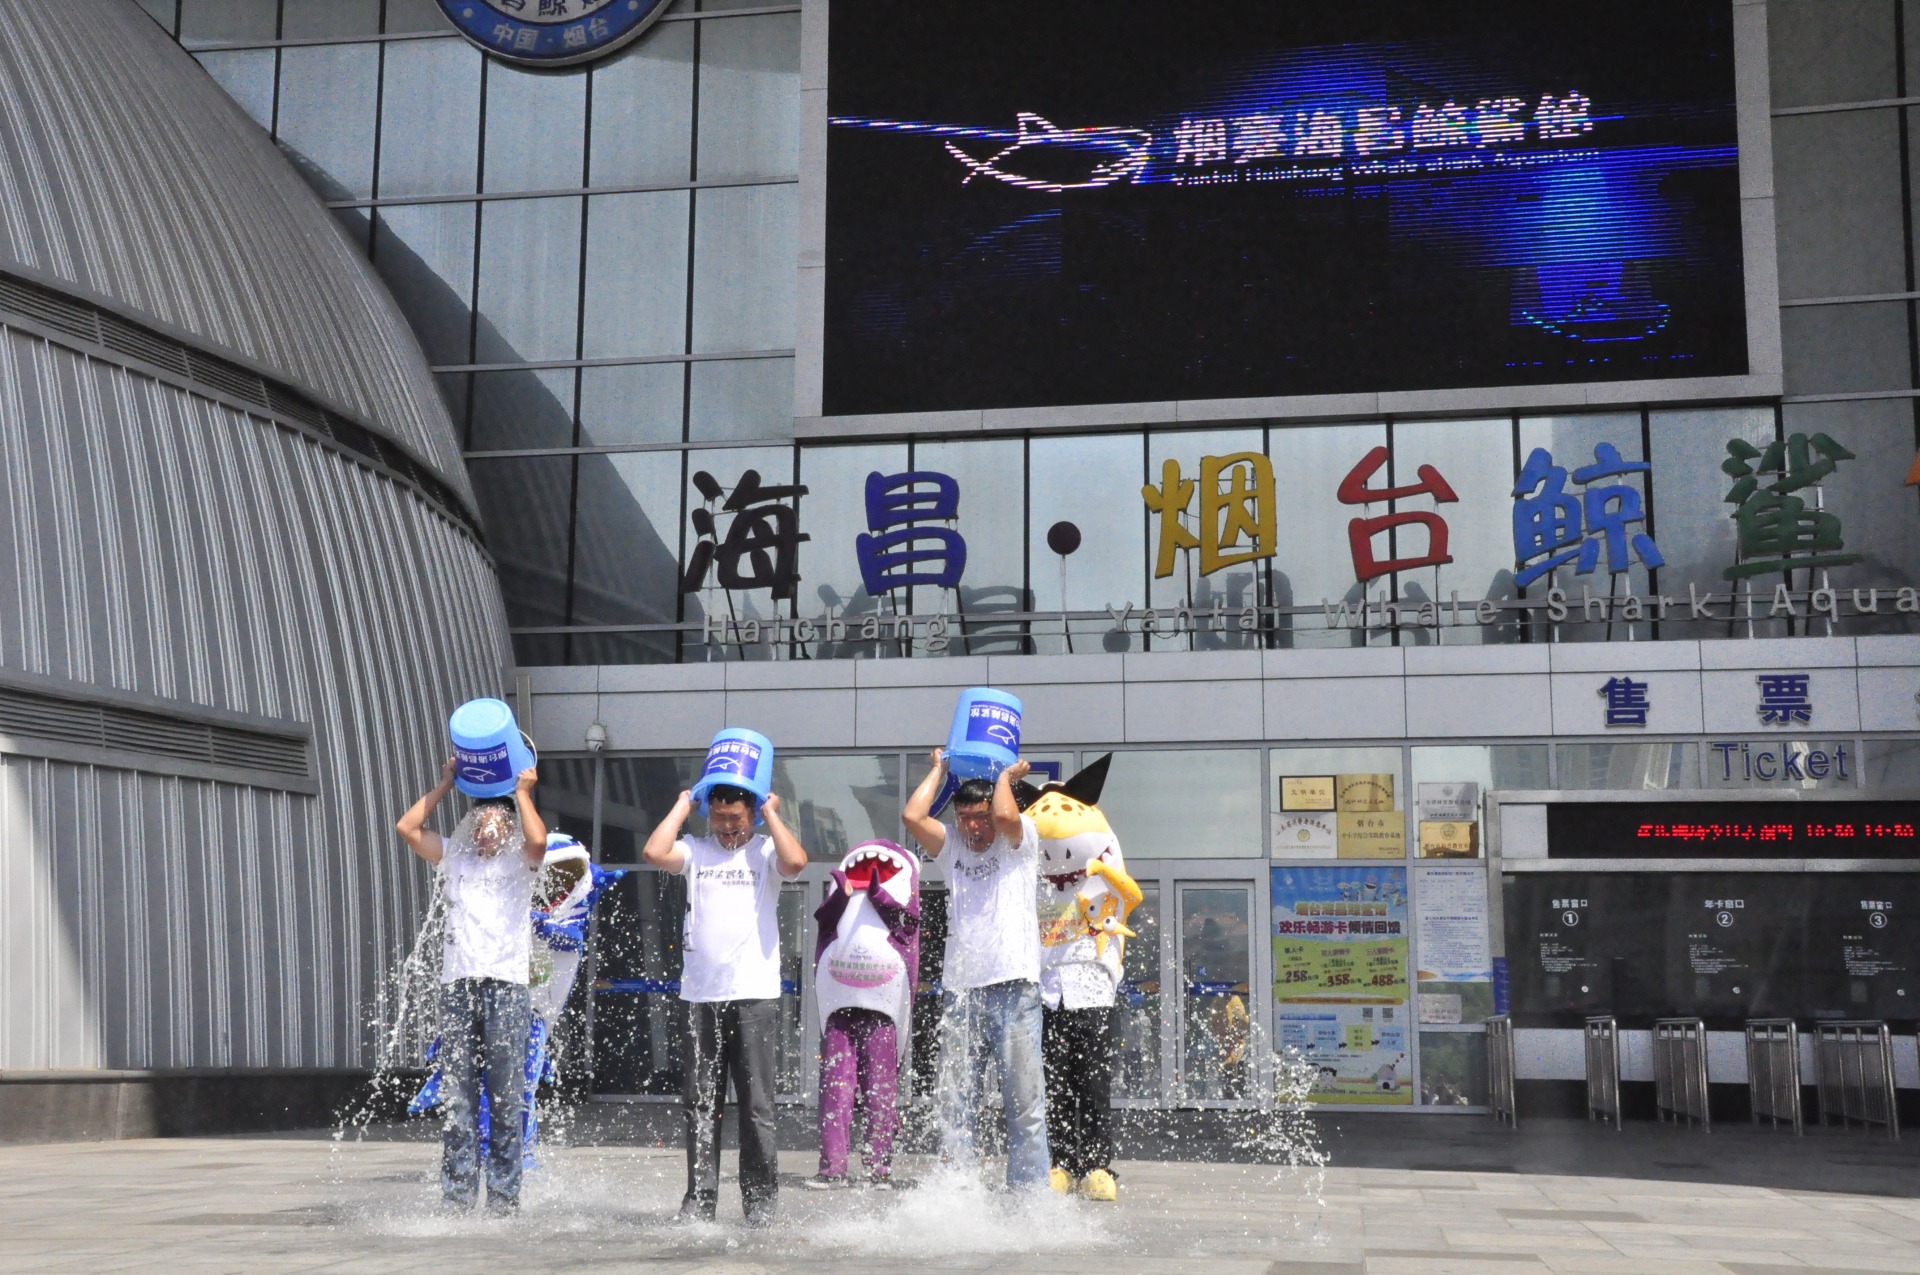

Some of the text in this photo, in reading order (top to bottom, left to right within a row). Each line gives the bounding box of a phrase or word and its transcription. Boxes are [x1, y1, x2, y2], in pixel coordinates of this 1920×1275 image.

[704, 582, 1919, 651] Haichang Yantai Whale Shark Aqua
[1598, 674, 1920, 727] 售票
[1712, 743, 1849, 780] Ticket
[1552, 898, 1588, 909] 售票窗口
[1704, 899, 1745, 909] 年卡窗口
[1285, 970, 1308, 983] 258
[1327, 973, 1350, 987] 358
[1371, 974, 1394, 987] 488
